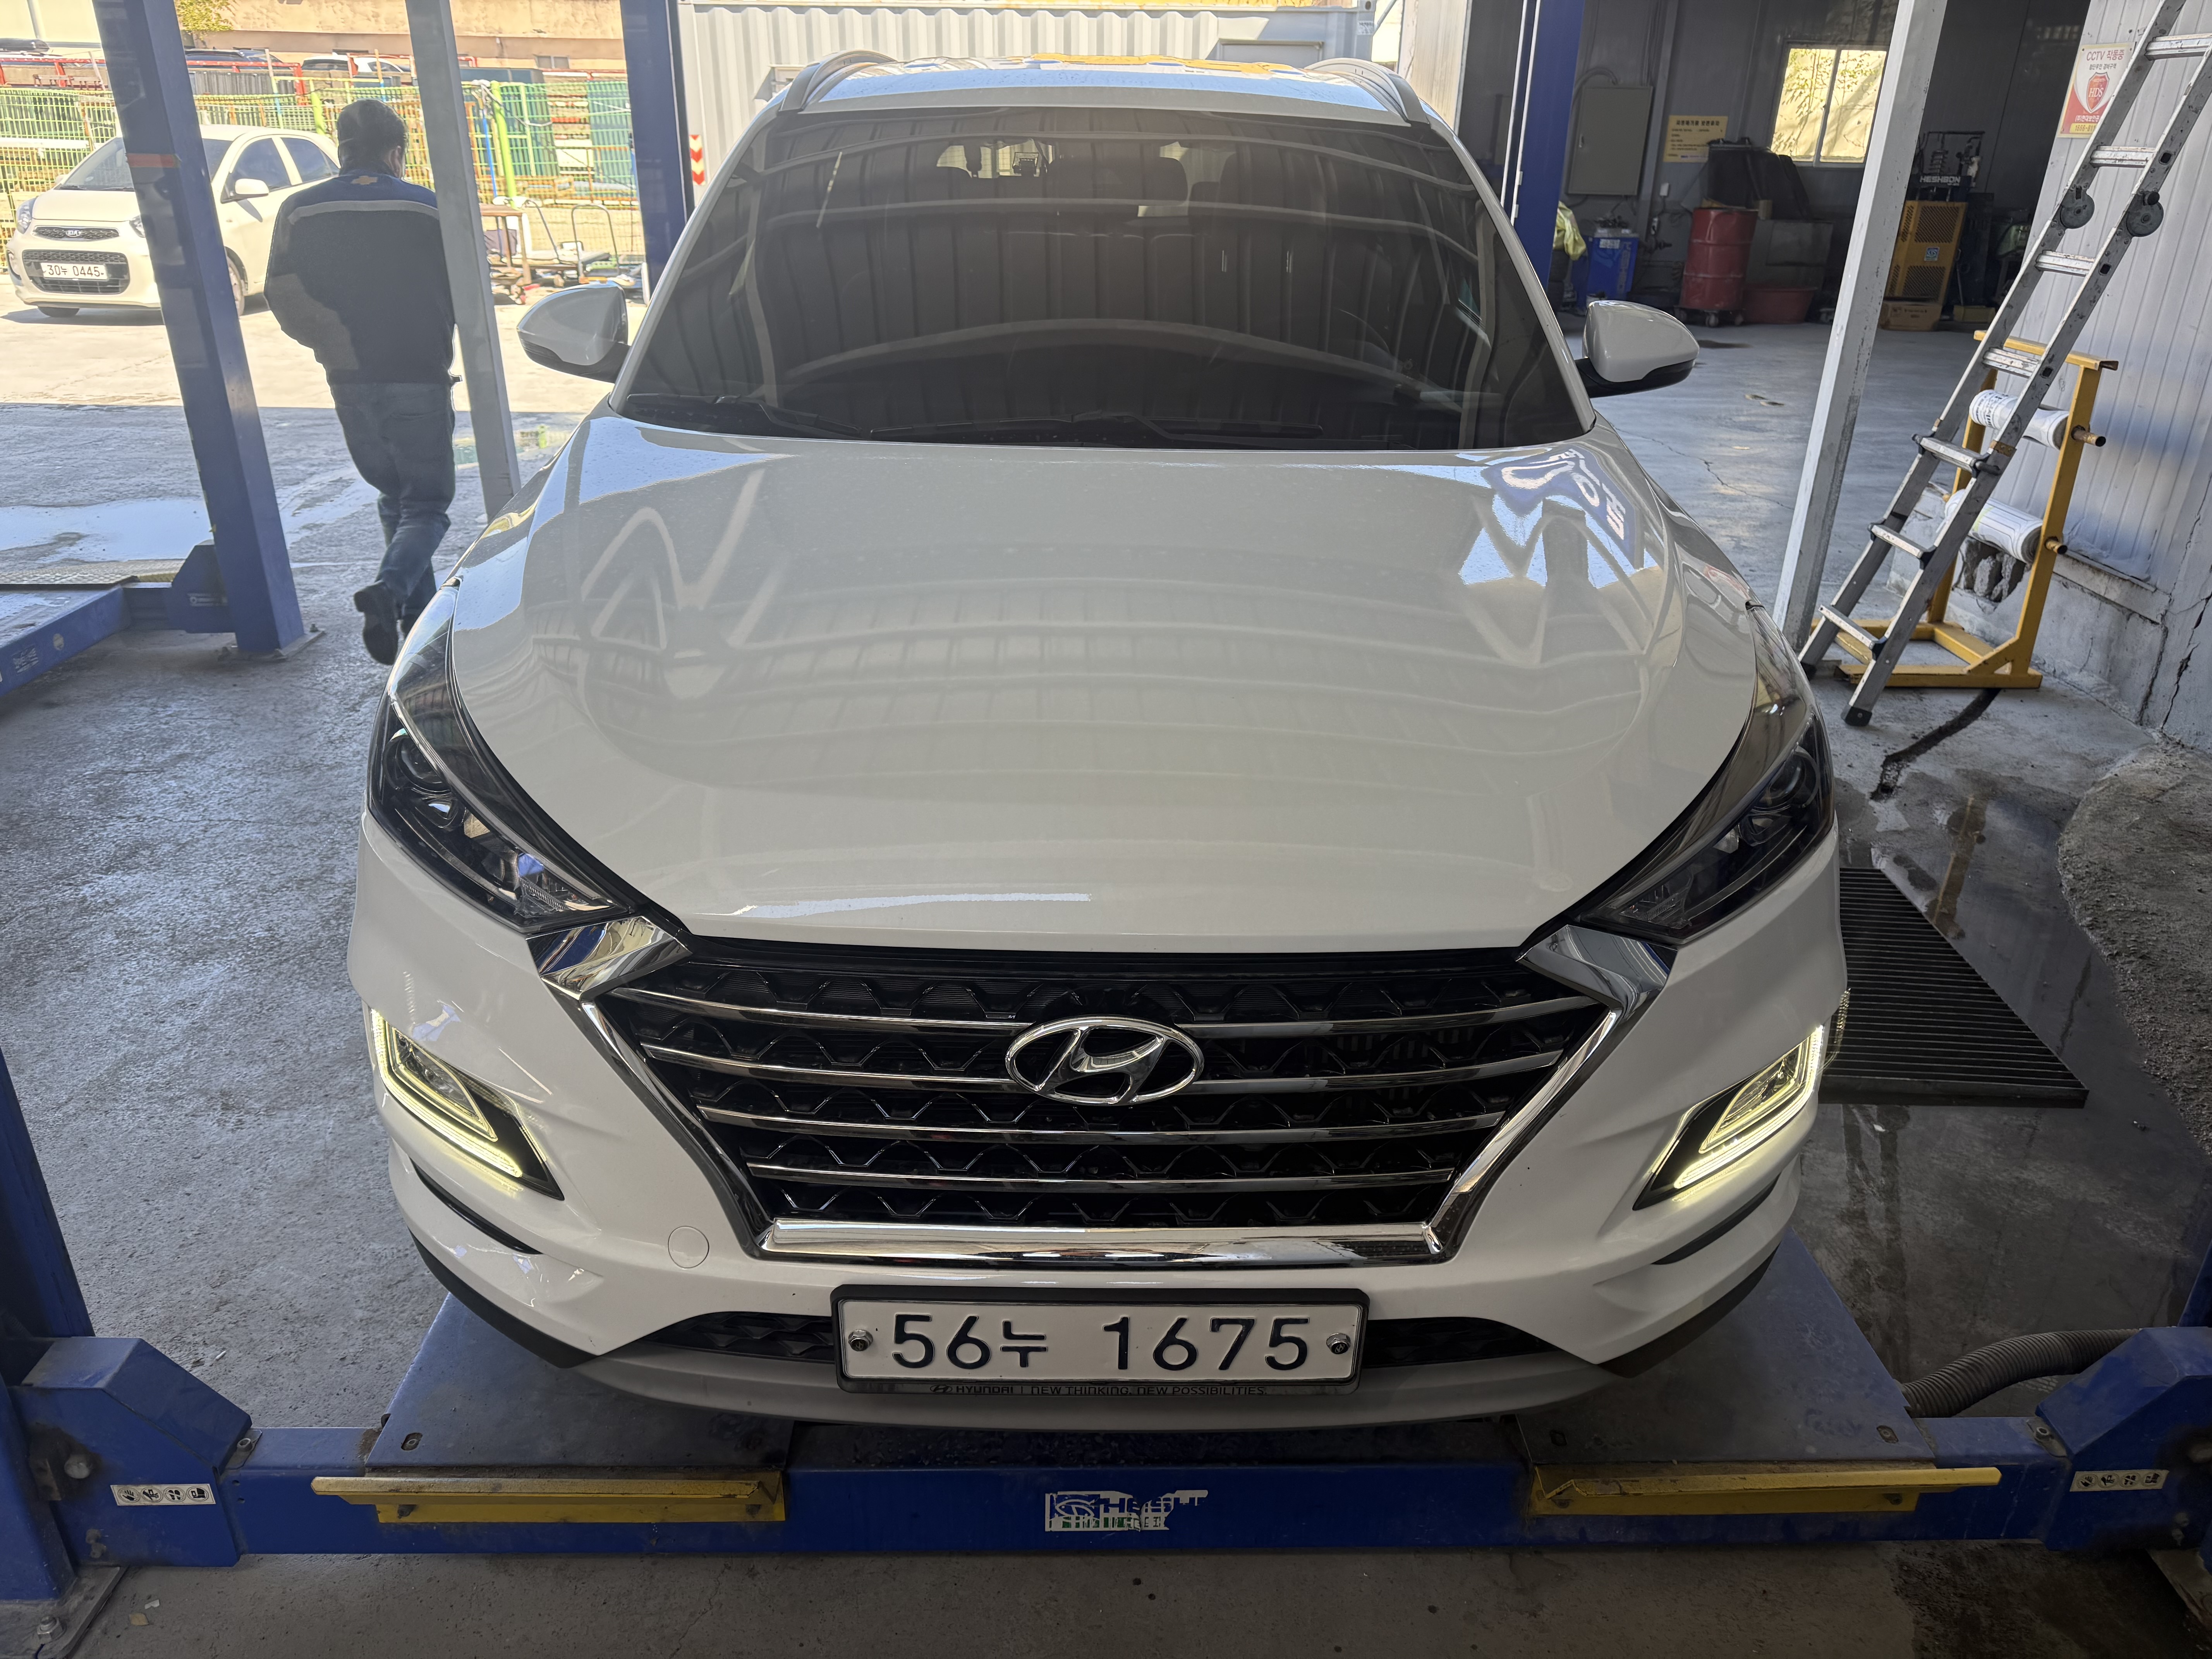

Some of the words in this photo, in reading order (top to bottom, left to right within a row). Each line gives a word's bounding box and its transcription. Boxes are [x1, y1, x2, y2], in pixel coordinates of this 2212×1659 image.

[2087, 51, 2106, 61] CCTV
[2106, 50, 2124, 60] 작동중
[2088, 87, 2104, 98] HDS
[47, 265, 68, 275] 30누
[72, 266, 100, 277] 0445
[892, 1313, 1049, 1370] 56누
[1102, 1316, 1309, 1372] 1675
[1031, 1386, 1062, 1394] NEW
[1065, 1386, 1132, 1395] THINKING.
[1137, 1386, 1168, 1395] NEW
[1172, 1387, 1267, 1395] POSSIBILITIES.
